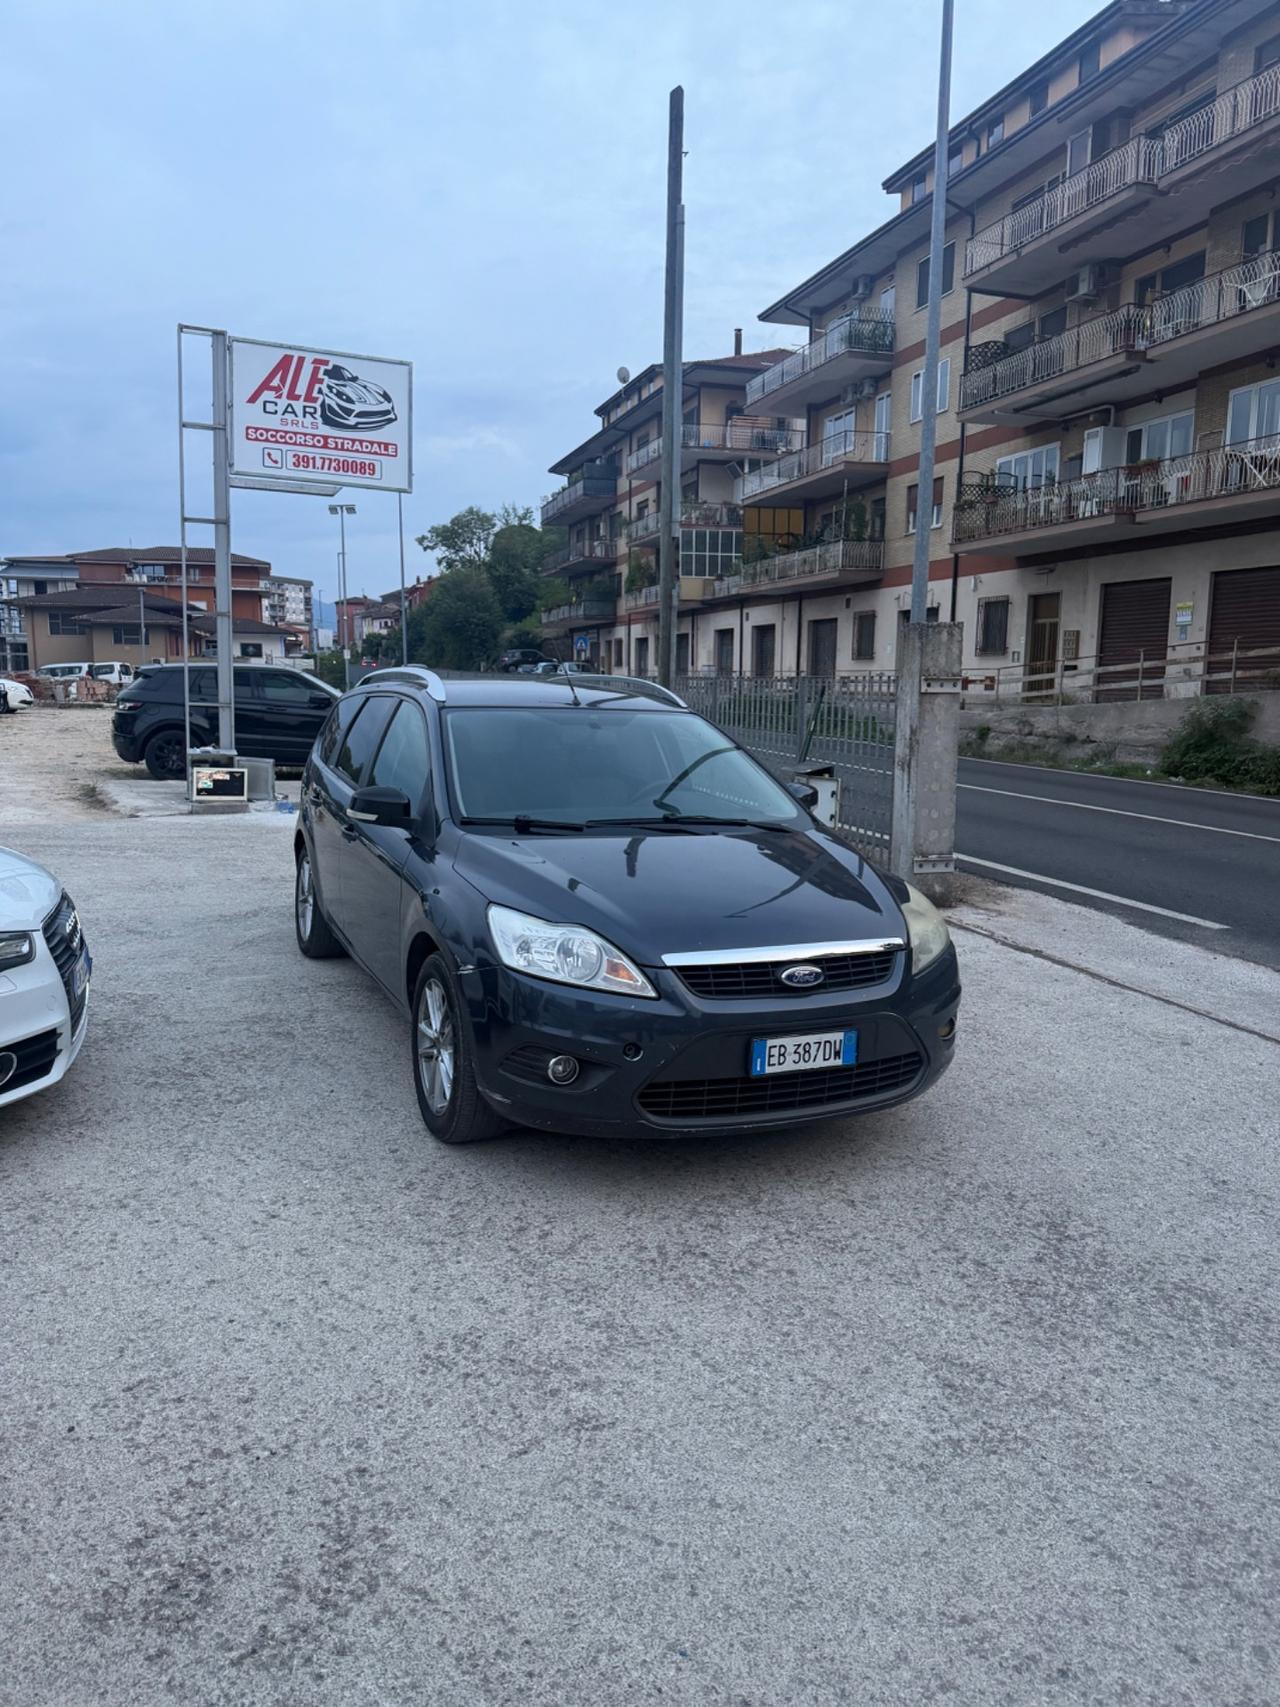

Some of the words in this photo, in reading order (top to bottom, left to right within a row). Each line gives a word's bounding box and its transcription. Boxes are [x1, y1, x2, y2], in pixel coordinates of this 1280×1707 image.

[246, 354, 330, 403] ALE
[262, 400, 318, 420] CAR
[279, 417, 320, 430] SRLS
[246, 428, 324, 447] SOCCORSO
[327, 438, 397, 456] STRADALE
[292, 453, 376, 476] 391.7730089
[767, 1044, 787, 1067] EB
[792, 1039, 842, 1064] 387DW
